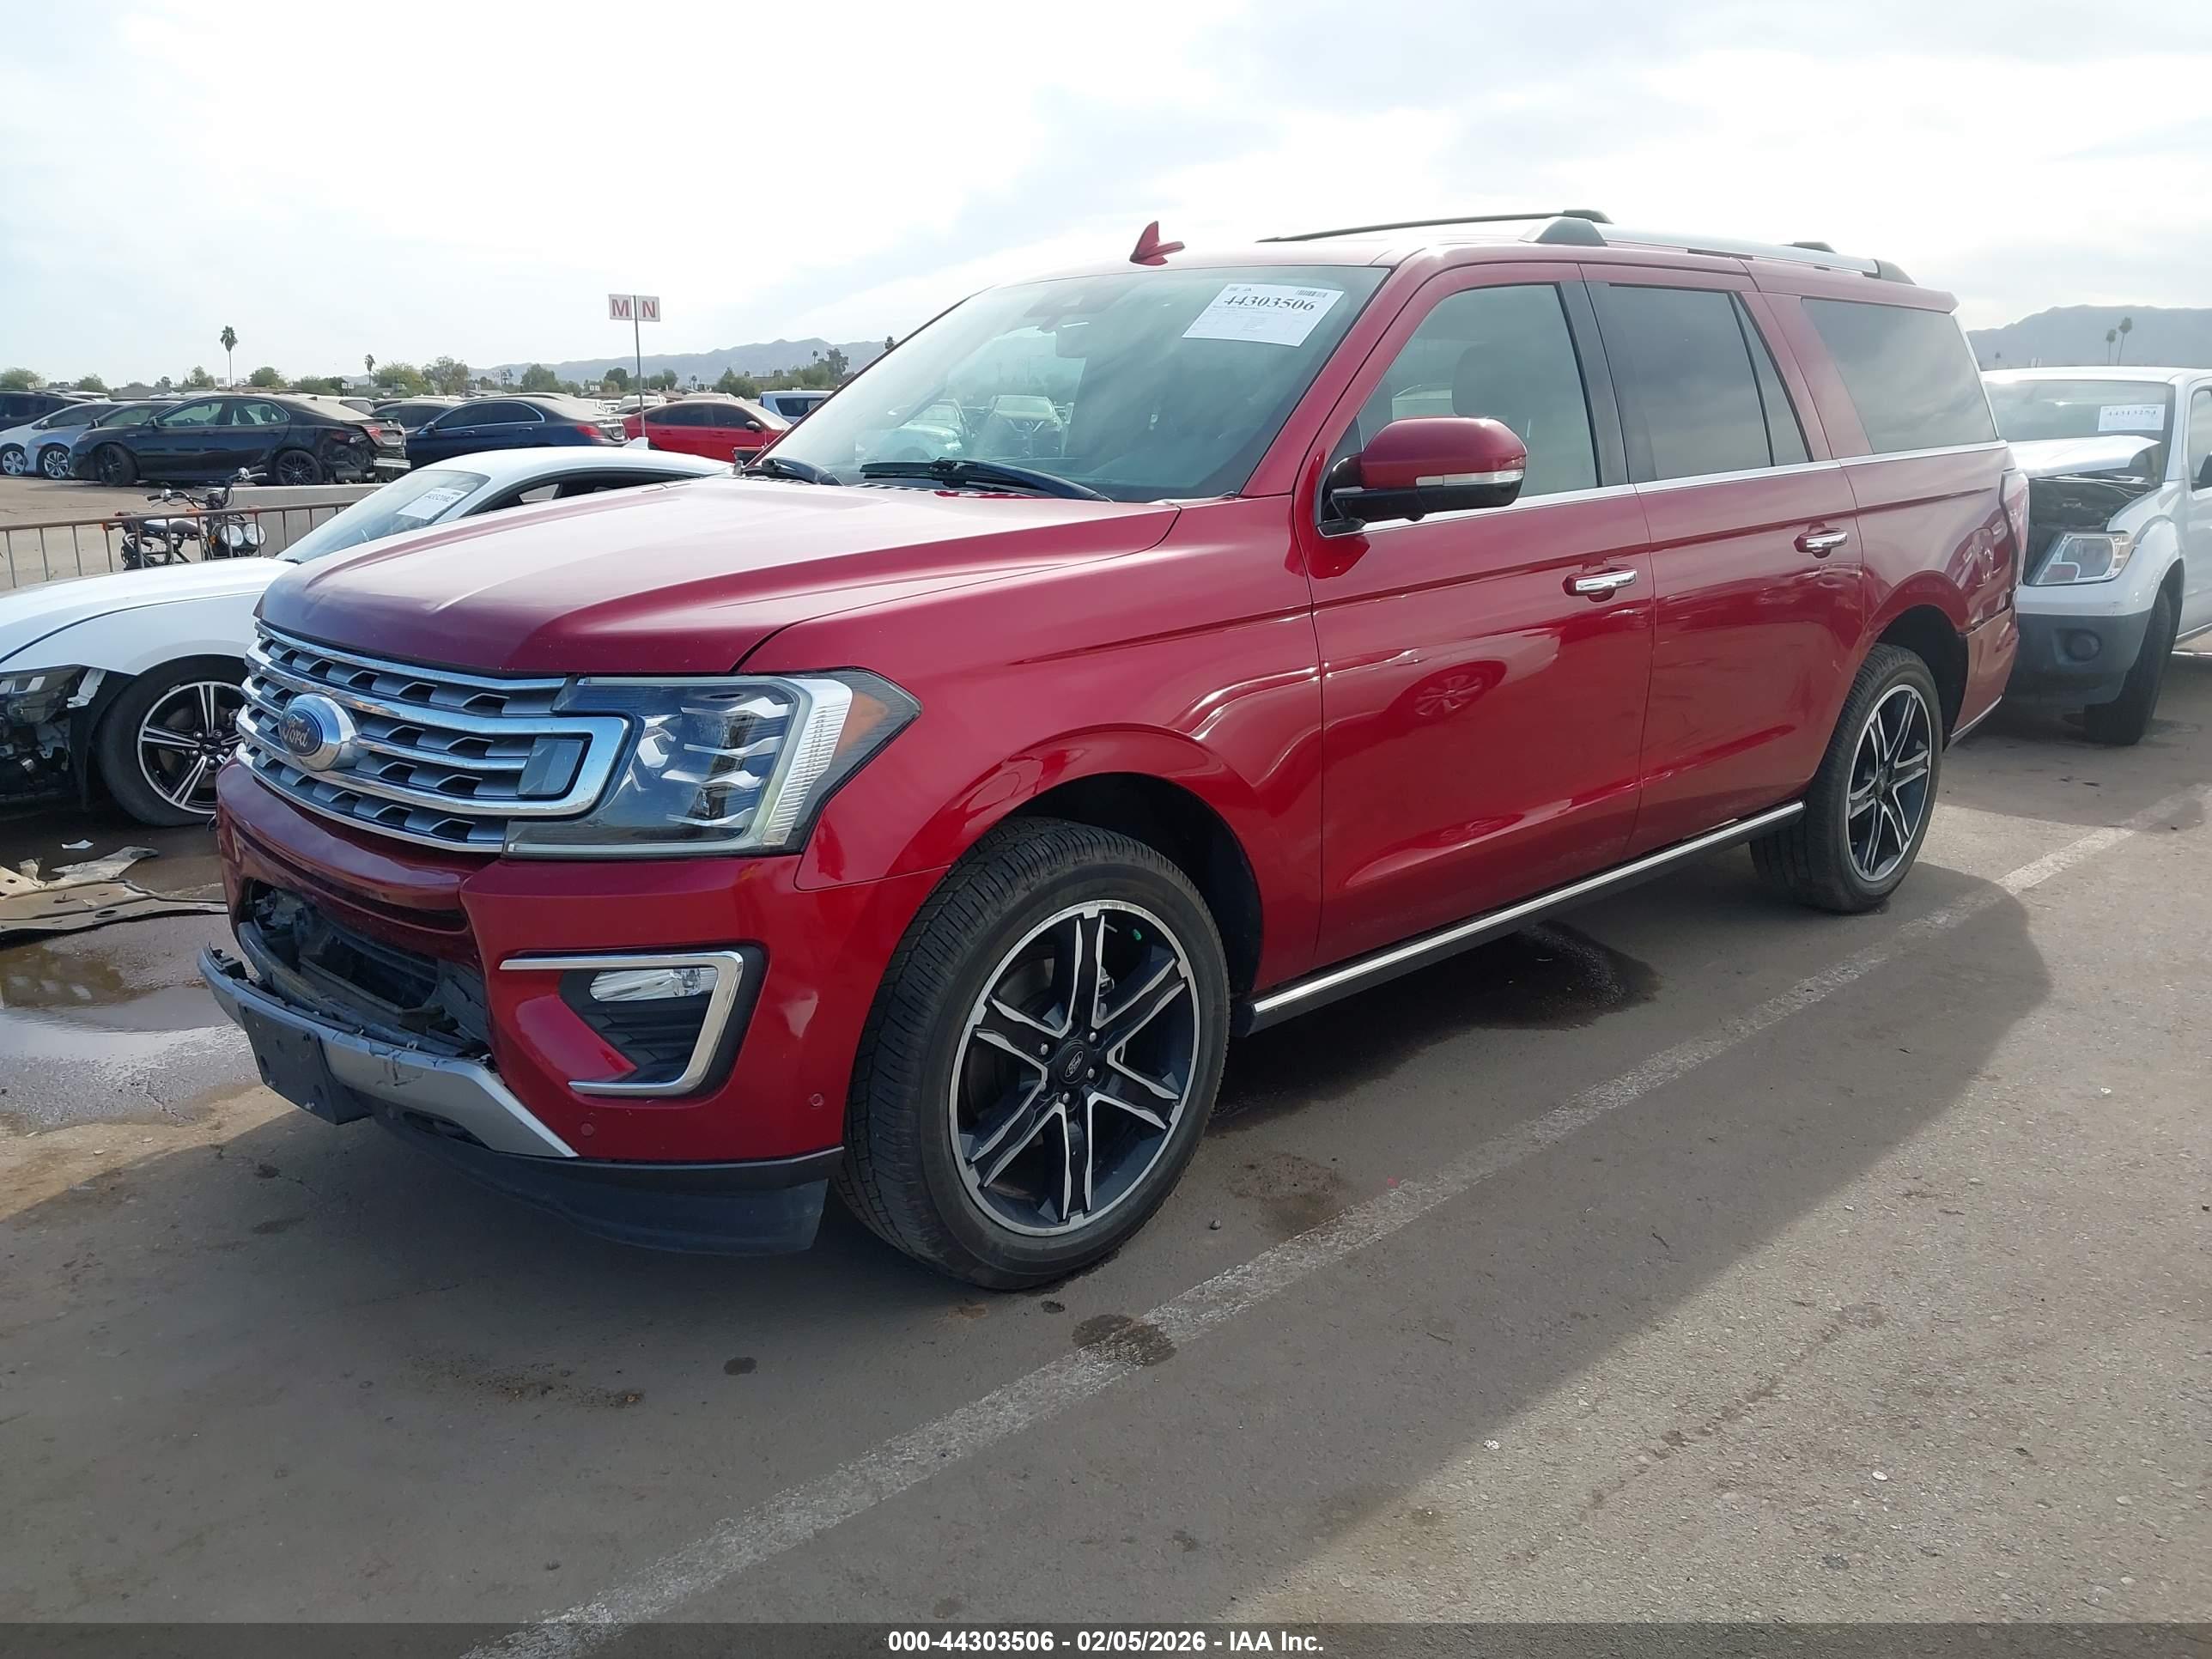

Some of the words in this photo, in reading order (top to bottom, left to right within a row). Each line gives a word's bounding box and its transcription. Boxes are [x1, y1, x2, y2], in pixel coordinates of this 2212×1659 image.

[611, 299, 629, 317] M
[642, 301, 656, 318] N
[1224, 295, 1317, 312] 44303506
[283, 714, 310, 747] Ford
